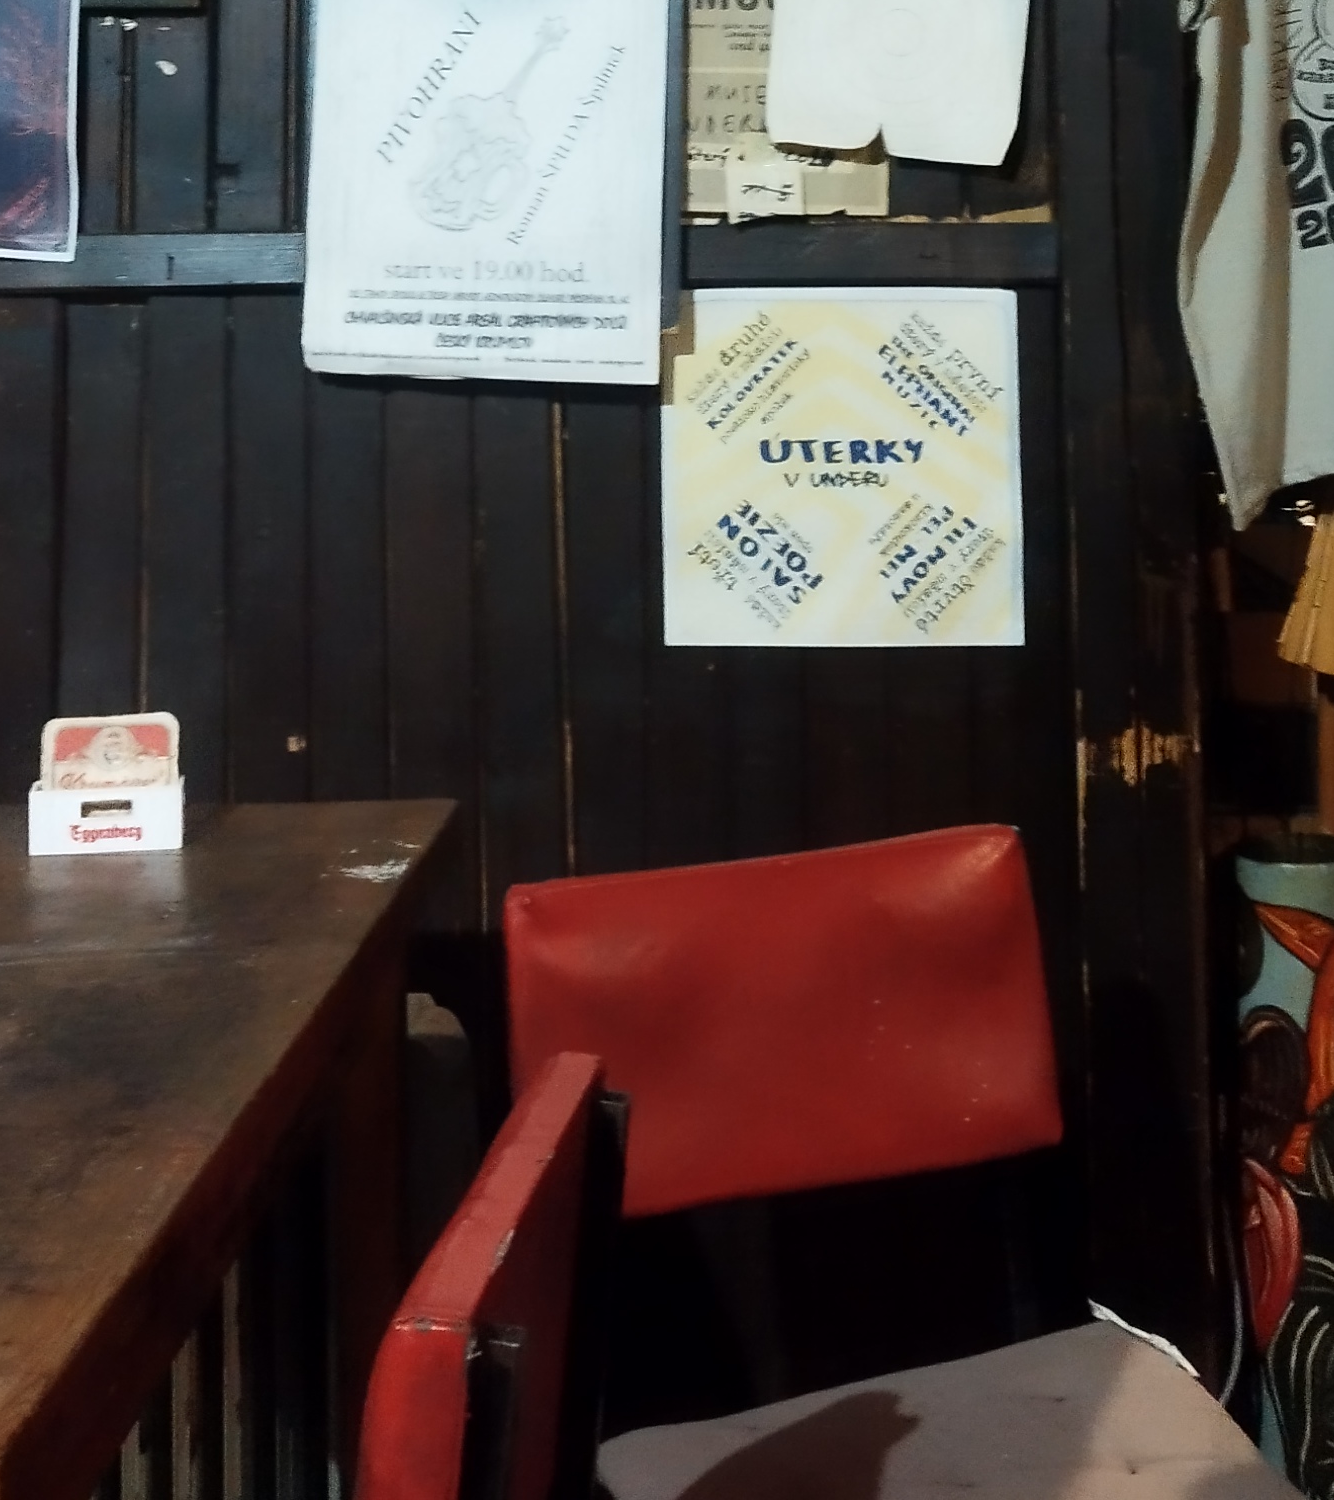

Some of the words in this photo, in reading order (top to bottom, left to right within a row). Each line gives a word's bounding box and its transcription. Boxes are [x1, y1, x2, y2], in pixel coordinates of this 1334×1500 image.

[505, 186, 551, 246] Roman
[383, 263, 432, 280] start
[472, 260, 535, 282] 19.00
[539, 261, 591, 283] hod.
[944, 348, 1006, 402] první
[809, 471, 890, 490] UNDERU
[716, 513, 809, 606] SALON
[734, 497, 825, 591] POEZIE
